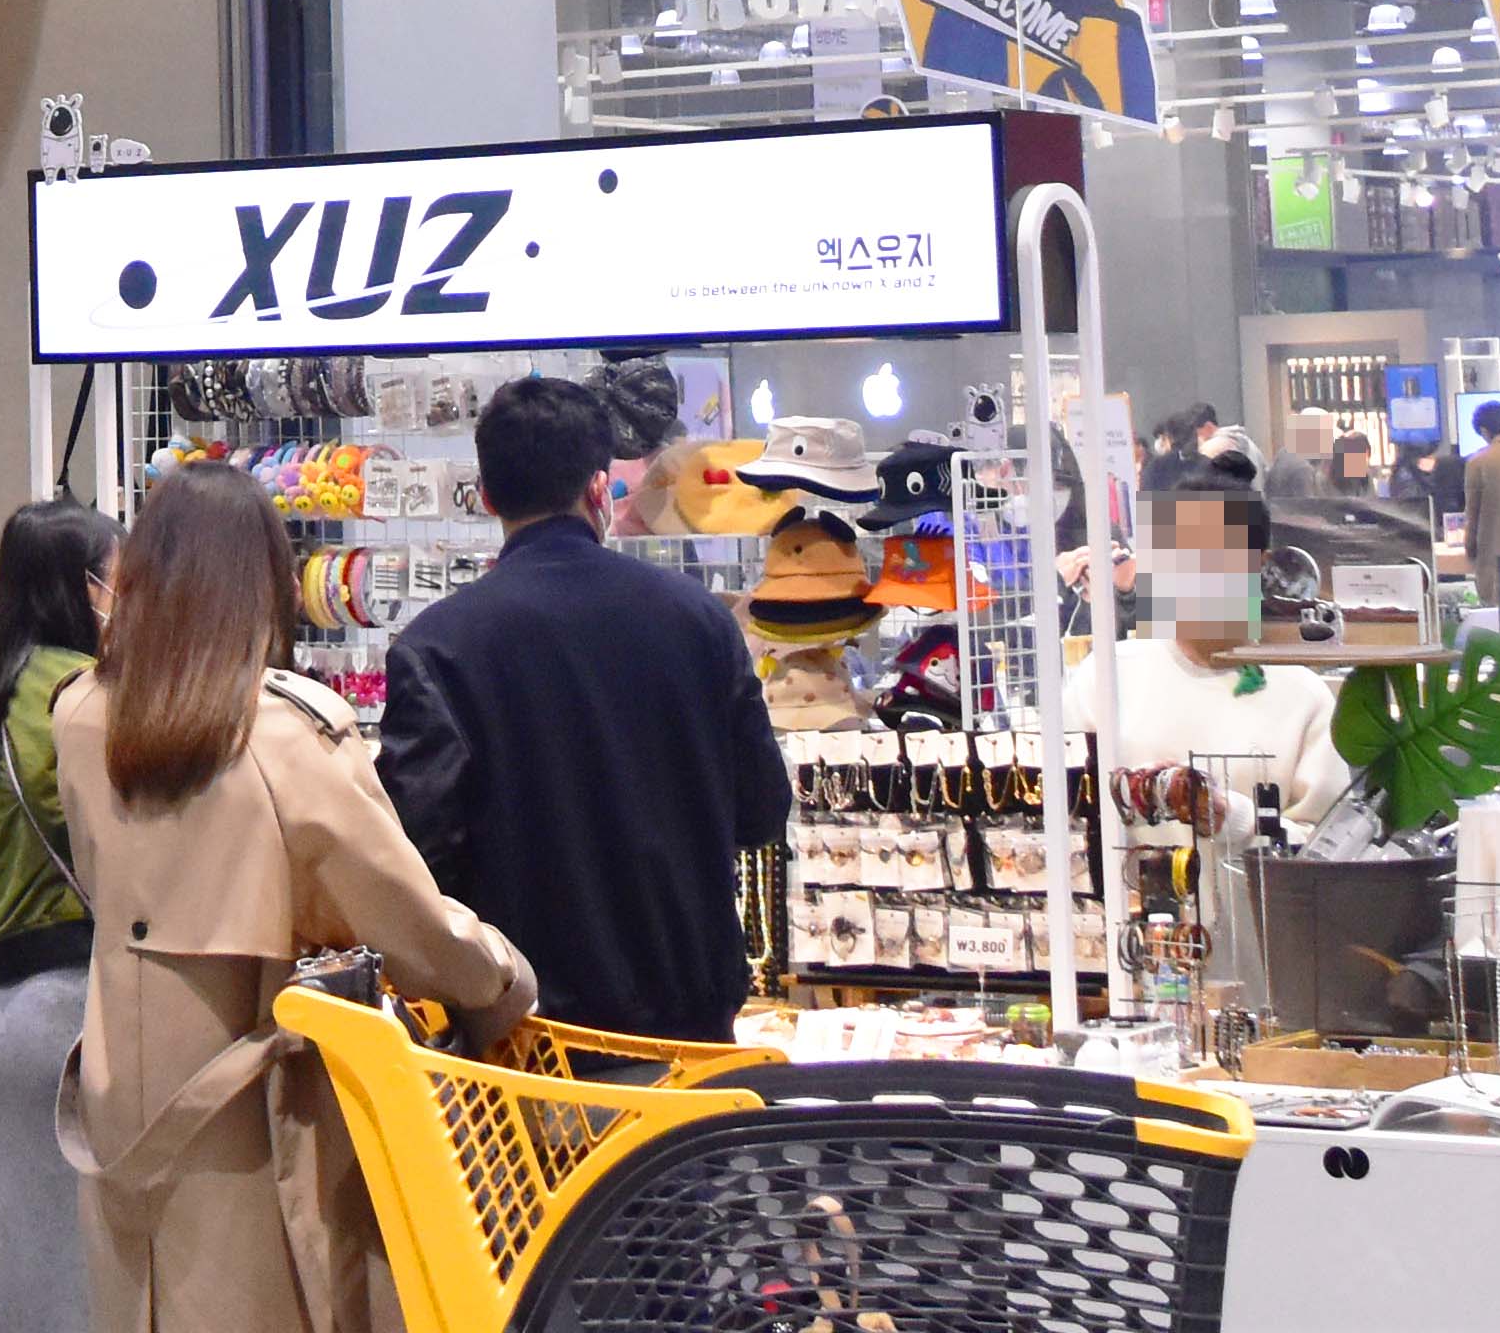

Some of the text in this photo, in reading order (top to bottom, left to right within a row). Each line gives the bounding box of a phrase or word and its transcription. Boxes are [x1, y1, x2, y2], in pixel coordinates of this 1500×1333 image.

[207, 188, 513, 323] XUZ
[816, 232, 933, 271] 엑스유지
[773, 280, 798, 294] the
